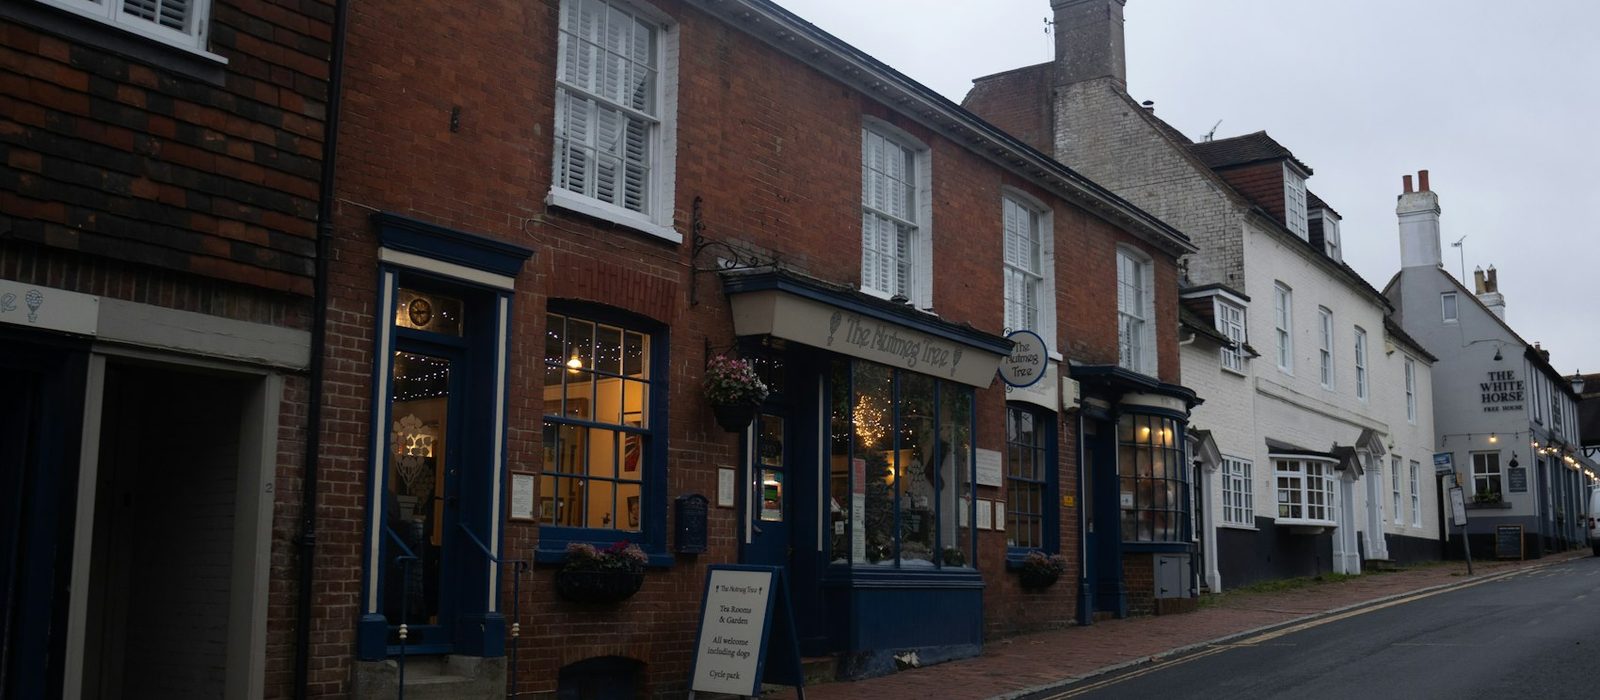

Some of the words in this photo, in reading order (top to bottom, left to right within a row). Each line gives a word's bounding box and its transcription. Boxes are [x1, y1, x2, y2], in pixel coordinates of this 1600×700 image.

[846, 317, 871, 348] The
[870, 323, 921, 367] Nutmeg
[921, 338, 950, 368] Tree
[1014, 341, 1030, 352] The
[1006, 353, 1039, 365] Nutmeg
[1012, 366, 1032, 377] Tree
[1487, 370, 1515, 381] THE
[1480, 380, 1524, 392] WHITE
[1481, 391, 1524, 403] HORSE
[265, 482, 273, 493] 2
[730, 605, 752, 614] Rooms
[719, 616, 725, 624] &
[726, 616, 748, 625] Garden
[712, 636, 722, 644] All
[723, 637, 749, 646] welcome
[707, 647, 735, 658] including
[736, 648, 750, 659] dogs
[709, 670, 725, 680] Cycle
[726, 671, 740, 680] park
